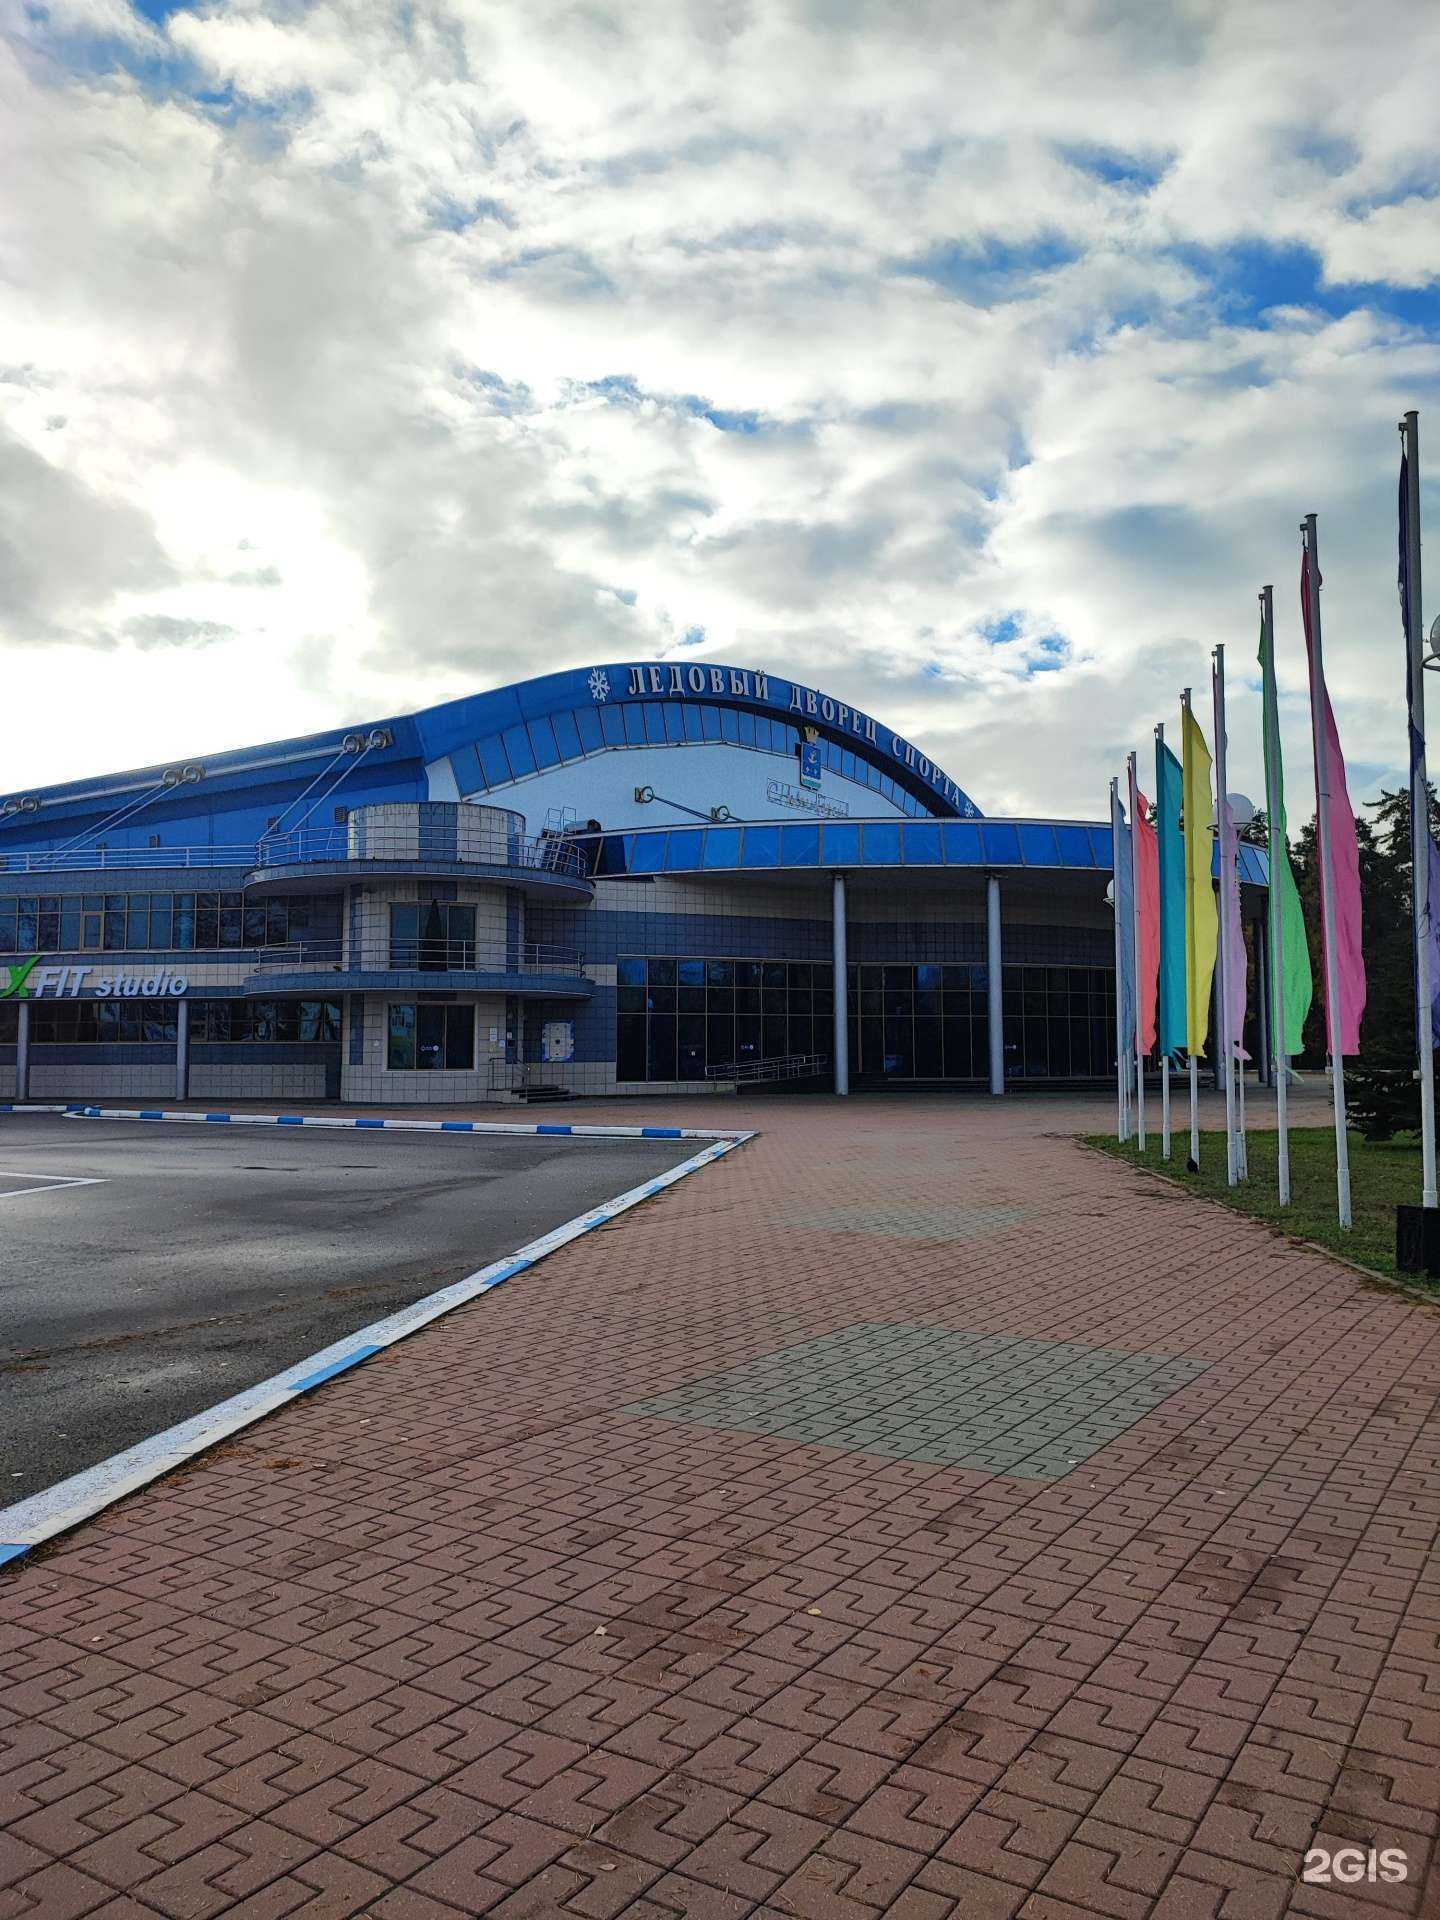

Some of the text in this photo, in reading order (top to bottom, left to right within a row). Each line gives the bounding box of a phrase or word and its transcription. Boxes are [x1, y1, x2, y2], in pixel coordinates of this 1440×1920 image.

[629, 666, 769, 700] ЛЕДОВЫЙ
[789, 685, 877, 746] ДВОРЕЦ
[892, 736, 960, 808] СПОРТА
[95, 966, 188, 997] studio
